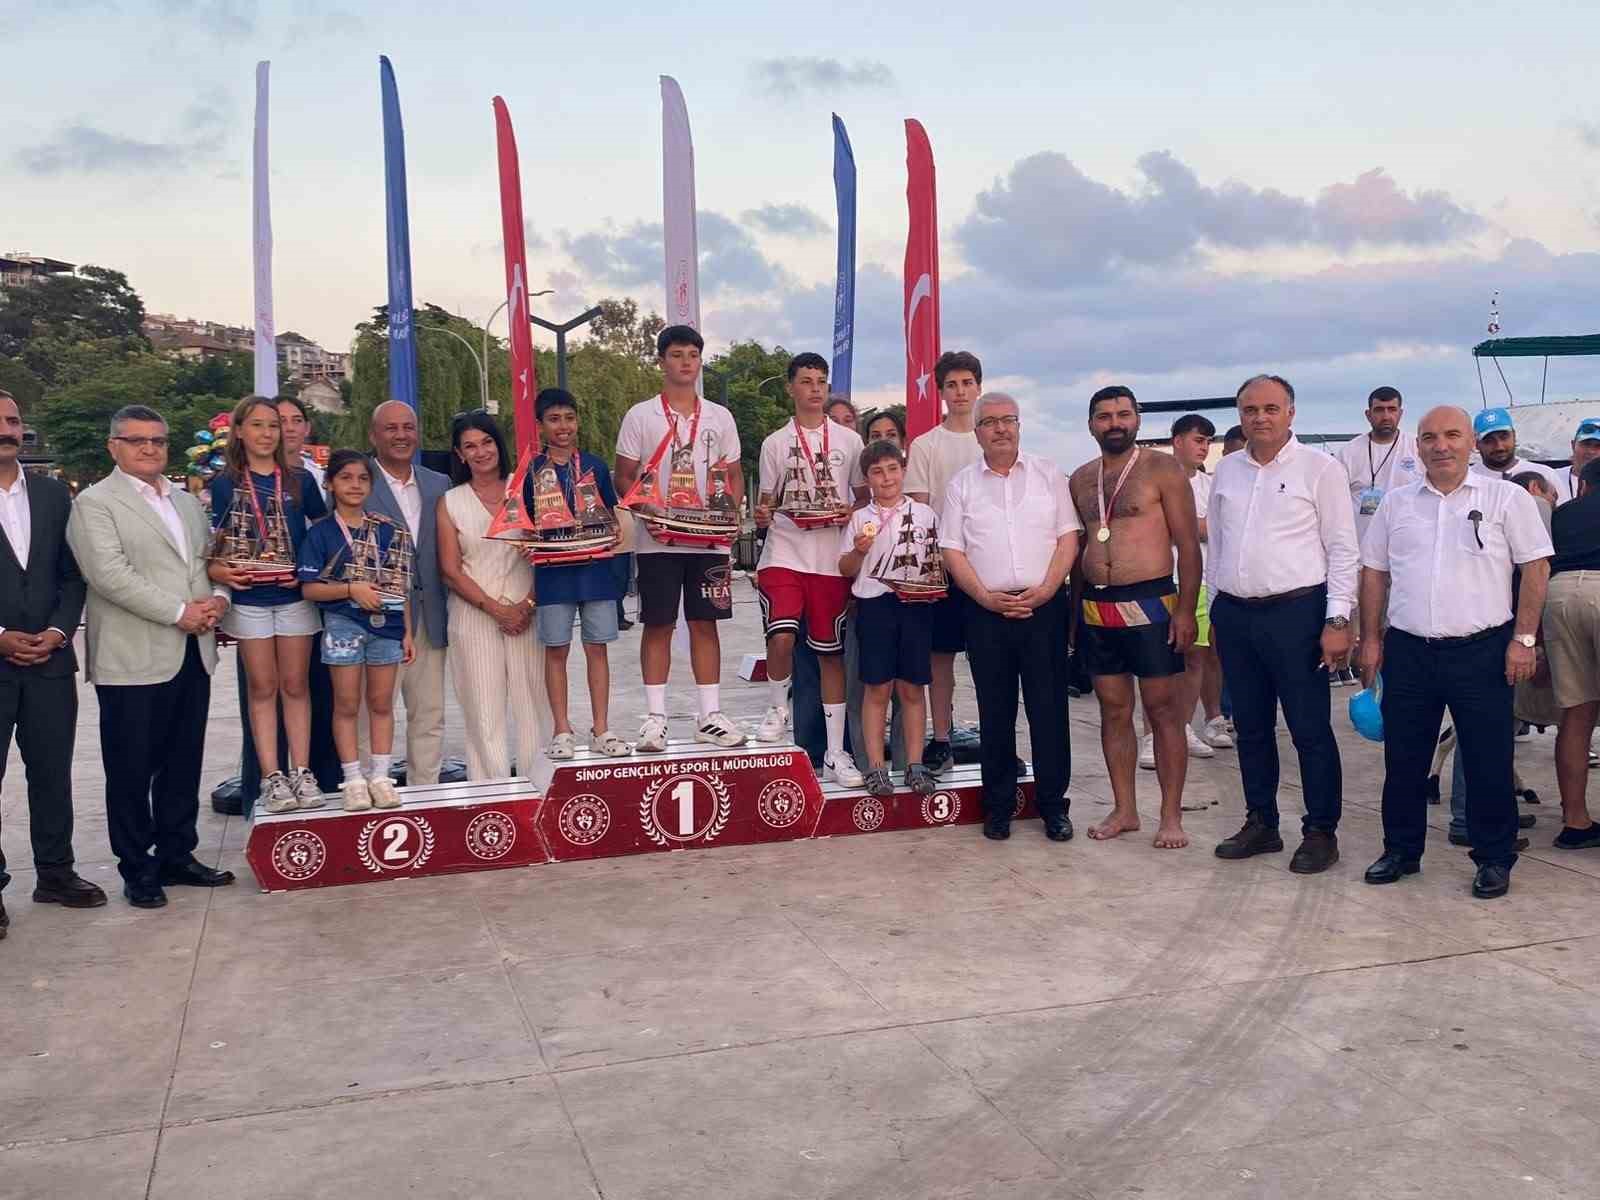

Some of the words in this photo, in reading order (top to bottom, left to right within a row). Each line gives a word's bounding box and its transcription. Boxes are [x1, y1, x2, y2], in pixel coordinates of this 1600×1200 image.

[575, 768, 611, 782] SİNOP
[613, 765, 662, 778] GENÇLİK
[663, 764, 678, 775] VE
[679, 762, 710, 773] SPOR
[711, 760, 721, 771] İL
[723, 755, 793, 770] MÜDÜRLÜĞÜ
[671, 781, 694, 835] 1
[934, 795, 949, 819] 3
[383, 823, 409, 861] 2
